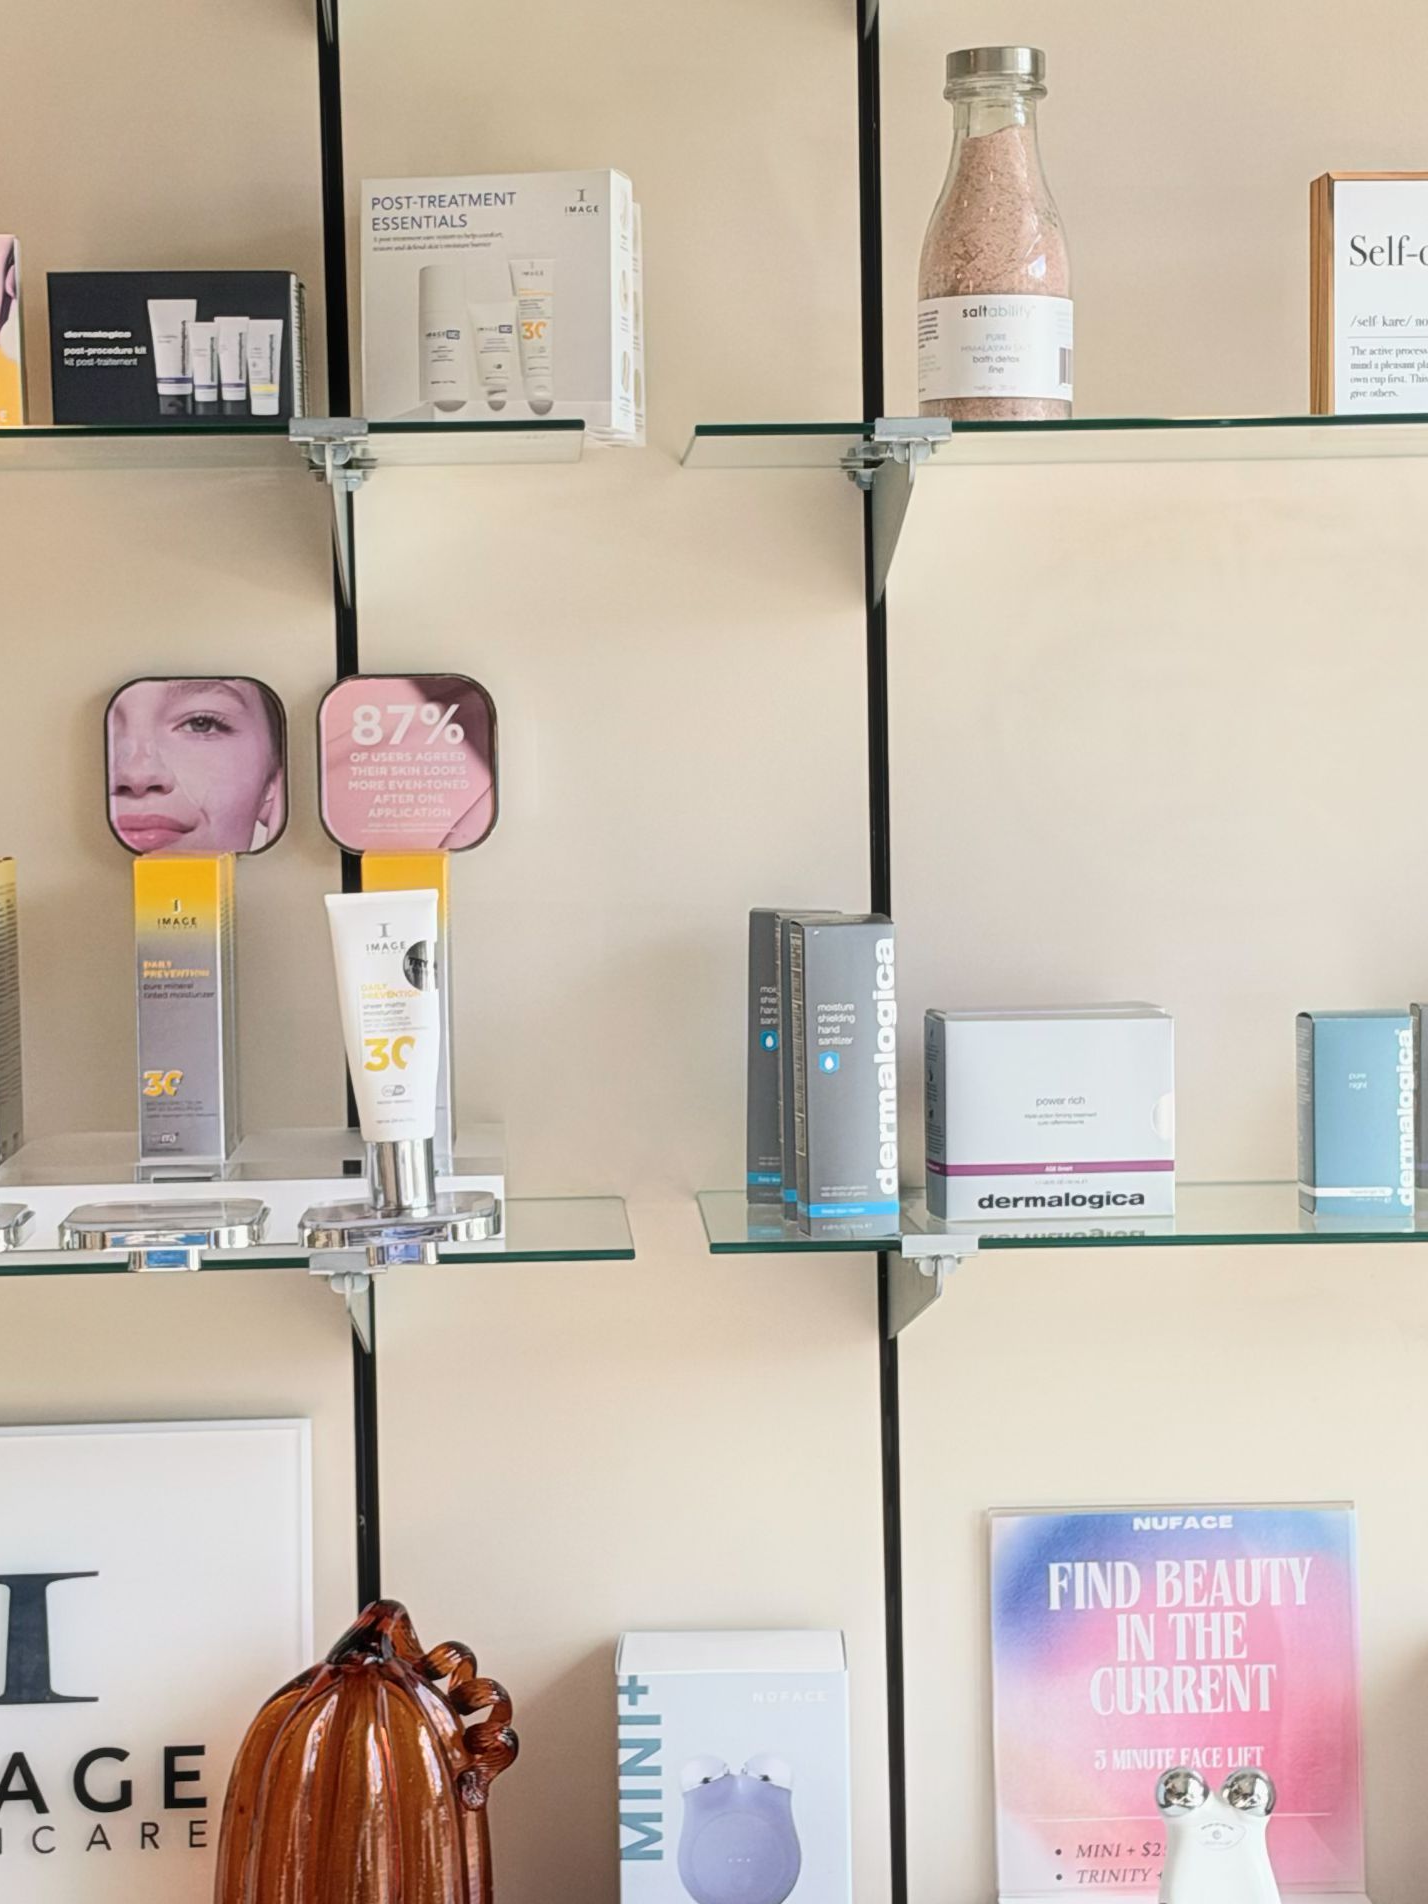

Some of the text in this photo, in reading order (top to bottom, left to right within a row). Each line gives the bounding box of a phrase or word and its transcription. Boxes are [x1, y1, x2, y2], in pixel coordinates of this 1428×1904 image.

[371, 191, 517, 211] POST-TREATMENT
[372, 214, 468, 232] ESSENTIALS
[962, 304, 1031, 320] saltability
[63, 330, 132, 340] dermalogica
[64, 346, 147, 356] post-procedure kit
[351, 704, 465, 746] 87%
[350, 752, 466, 762] OF USERS AGREED
[362, 1035, 416, 1072] 30
[873, 937, 899, 1195] dermalogica
[977, 1190, 1146, 1211] dermalogica
[1131, 1514, 1234, 1532] NUFACE
[1047, 1555, 1313, 1612] FIND BEAUTY
[1115, 1612, 1248, 1662] IN THE
[1089, 1663, 1278, 1717] CURRENT
[617, 1674, 664, 1862] MINI+
[1113, 1747, 1175, 1771] MINUTE
[1179, 1747, 1221, 1769] FACE
[1224, 1745, 1265, 1768] LIFT
[1076, 1868, 1153, 1884] TRINITY
